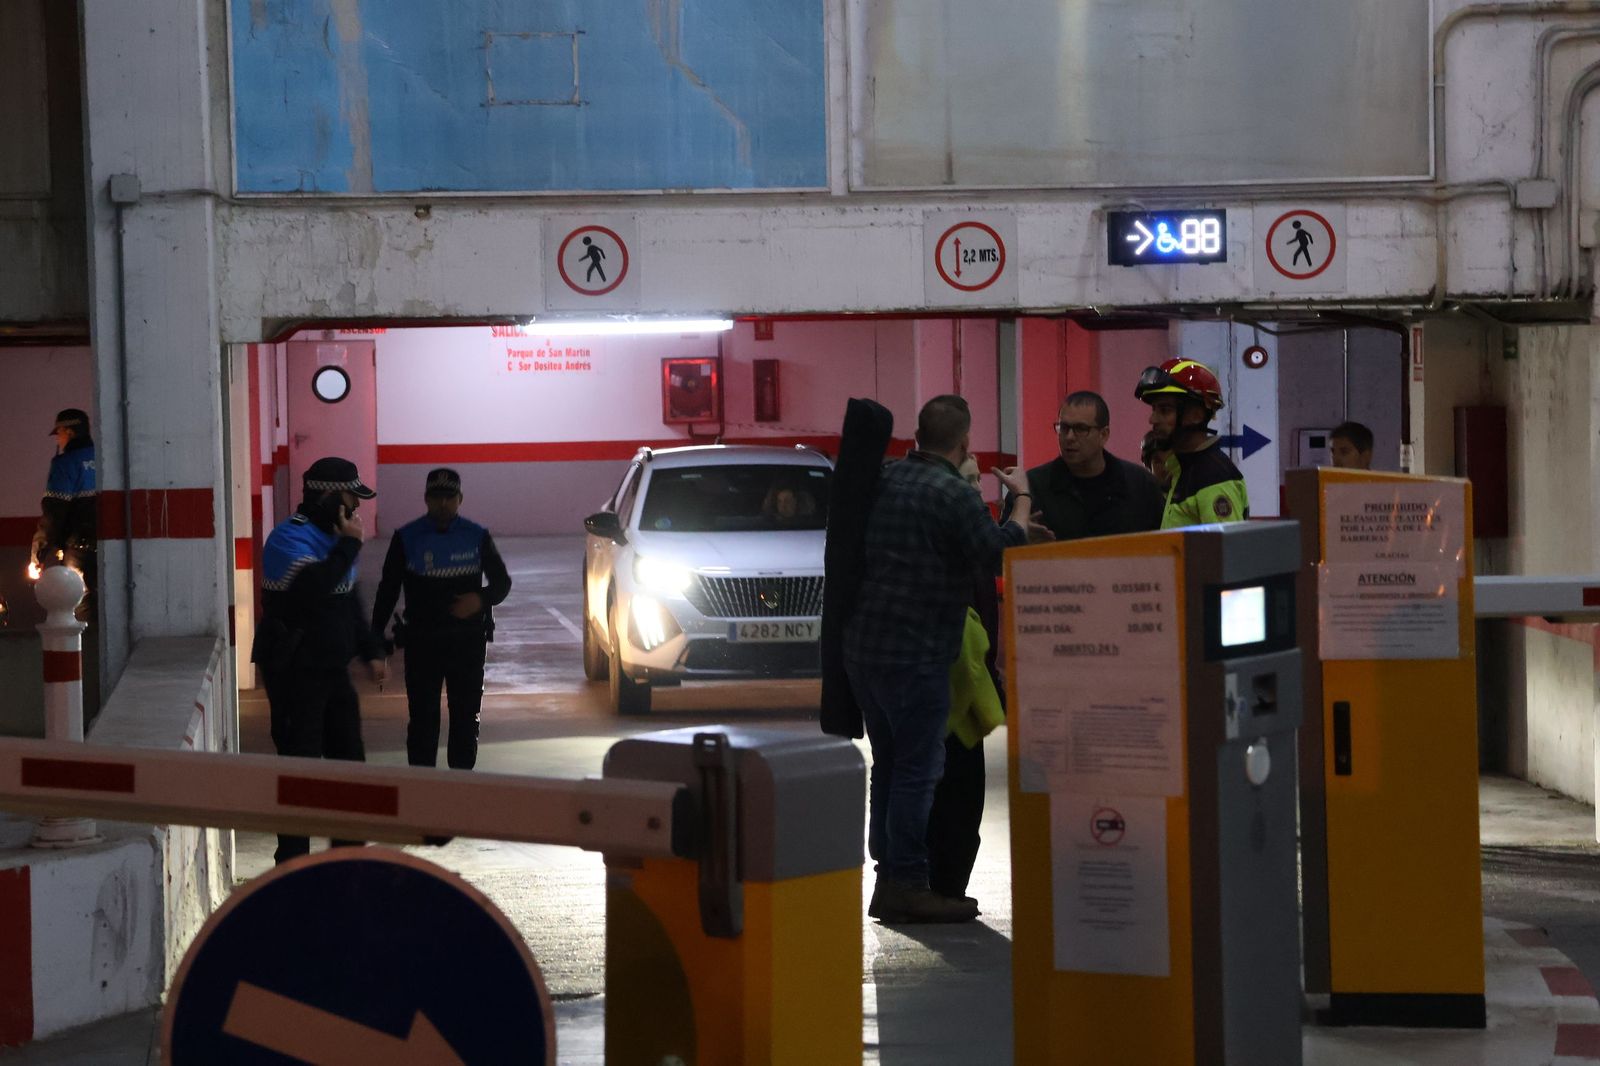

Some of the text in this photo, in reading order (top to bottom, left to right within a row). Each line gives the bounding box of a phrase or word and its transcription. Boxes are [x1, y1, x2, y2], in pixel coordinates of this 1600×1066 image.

[1181, 218, 1220, 254] 88
[963, 248, 999, 265] 2,2 MTS.
[507, 348, 533, 360] Parque
[537, 348, 546, 357] de
[549, 348, 563, 357] San
[519, 361, 531, 371] Sor
[1358, 572, 1416, 585] ATENCIÓN
[740, 621, 814, 638] 4282 NCY
